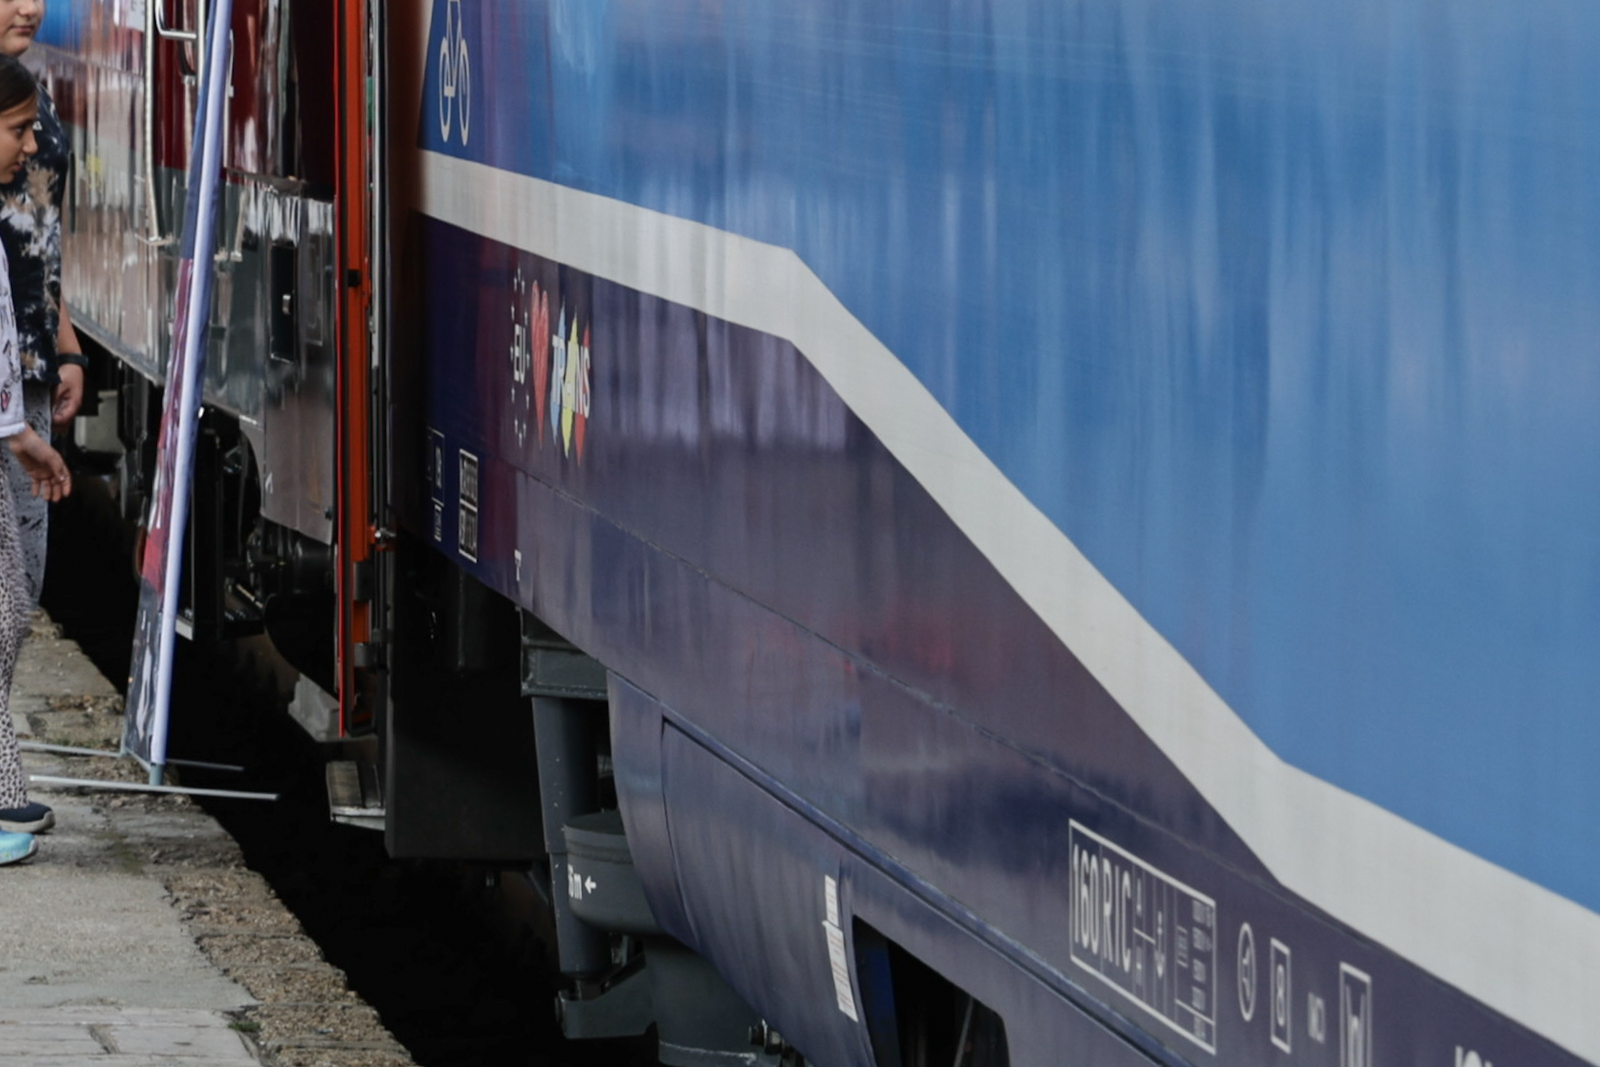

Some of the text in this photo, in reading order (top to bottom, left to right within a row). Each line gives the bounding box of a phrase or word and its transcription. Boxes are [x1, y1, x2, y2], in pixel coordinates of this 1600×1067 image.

[514, 324, 526, 385] EU
[1072, 843, 1100, 956] 160
[1102, 857, 1132, 974] RIC
[1276, 963, 1286, 1028] 8
